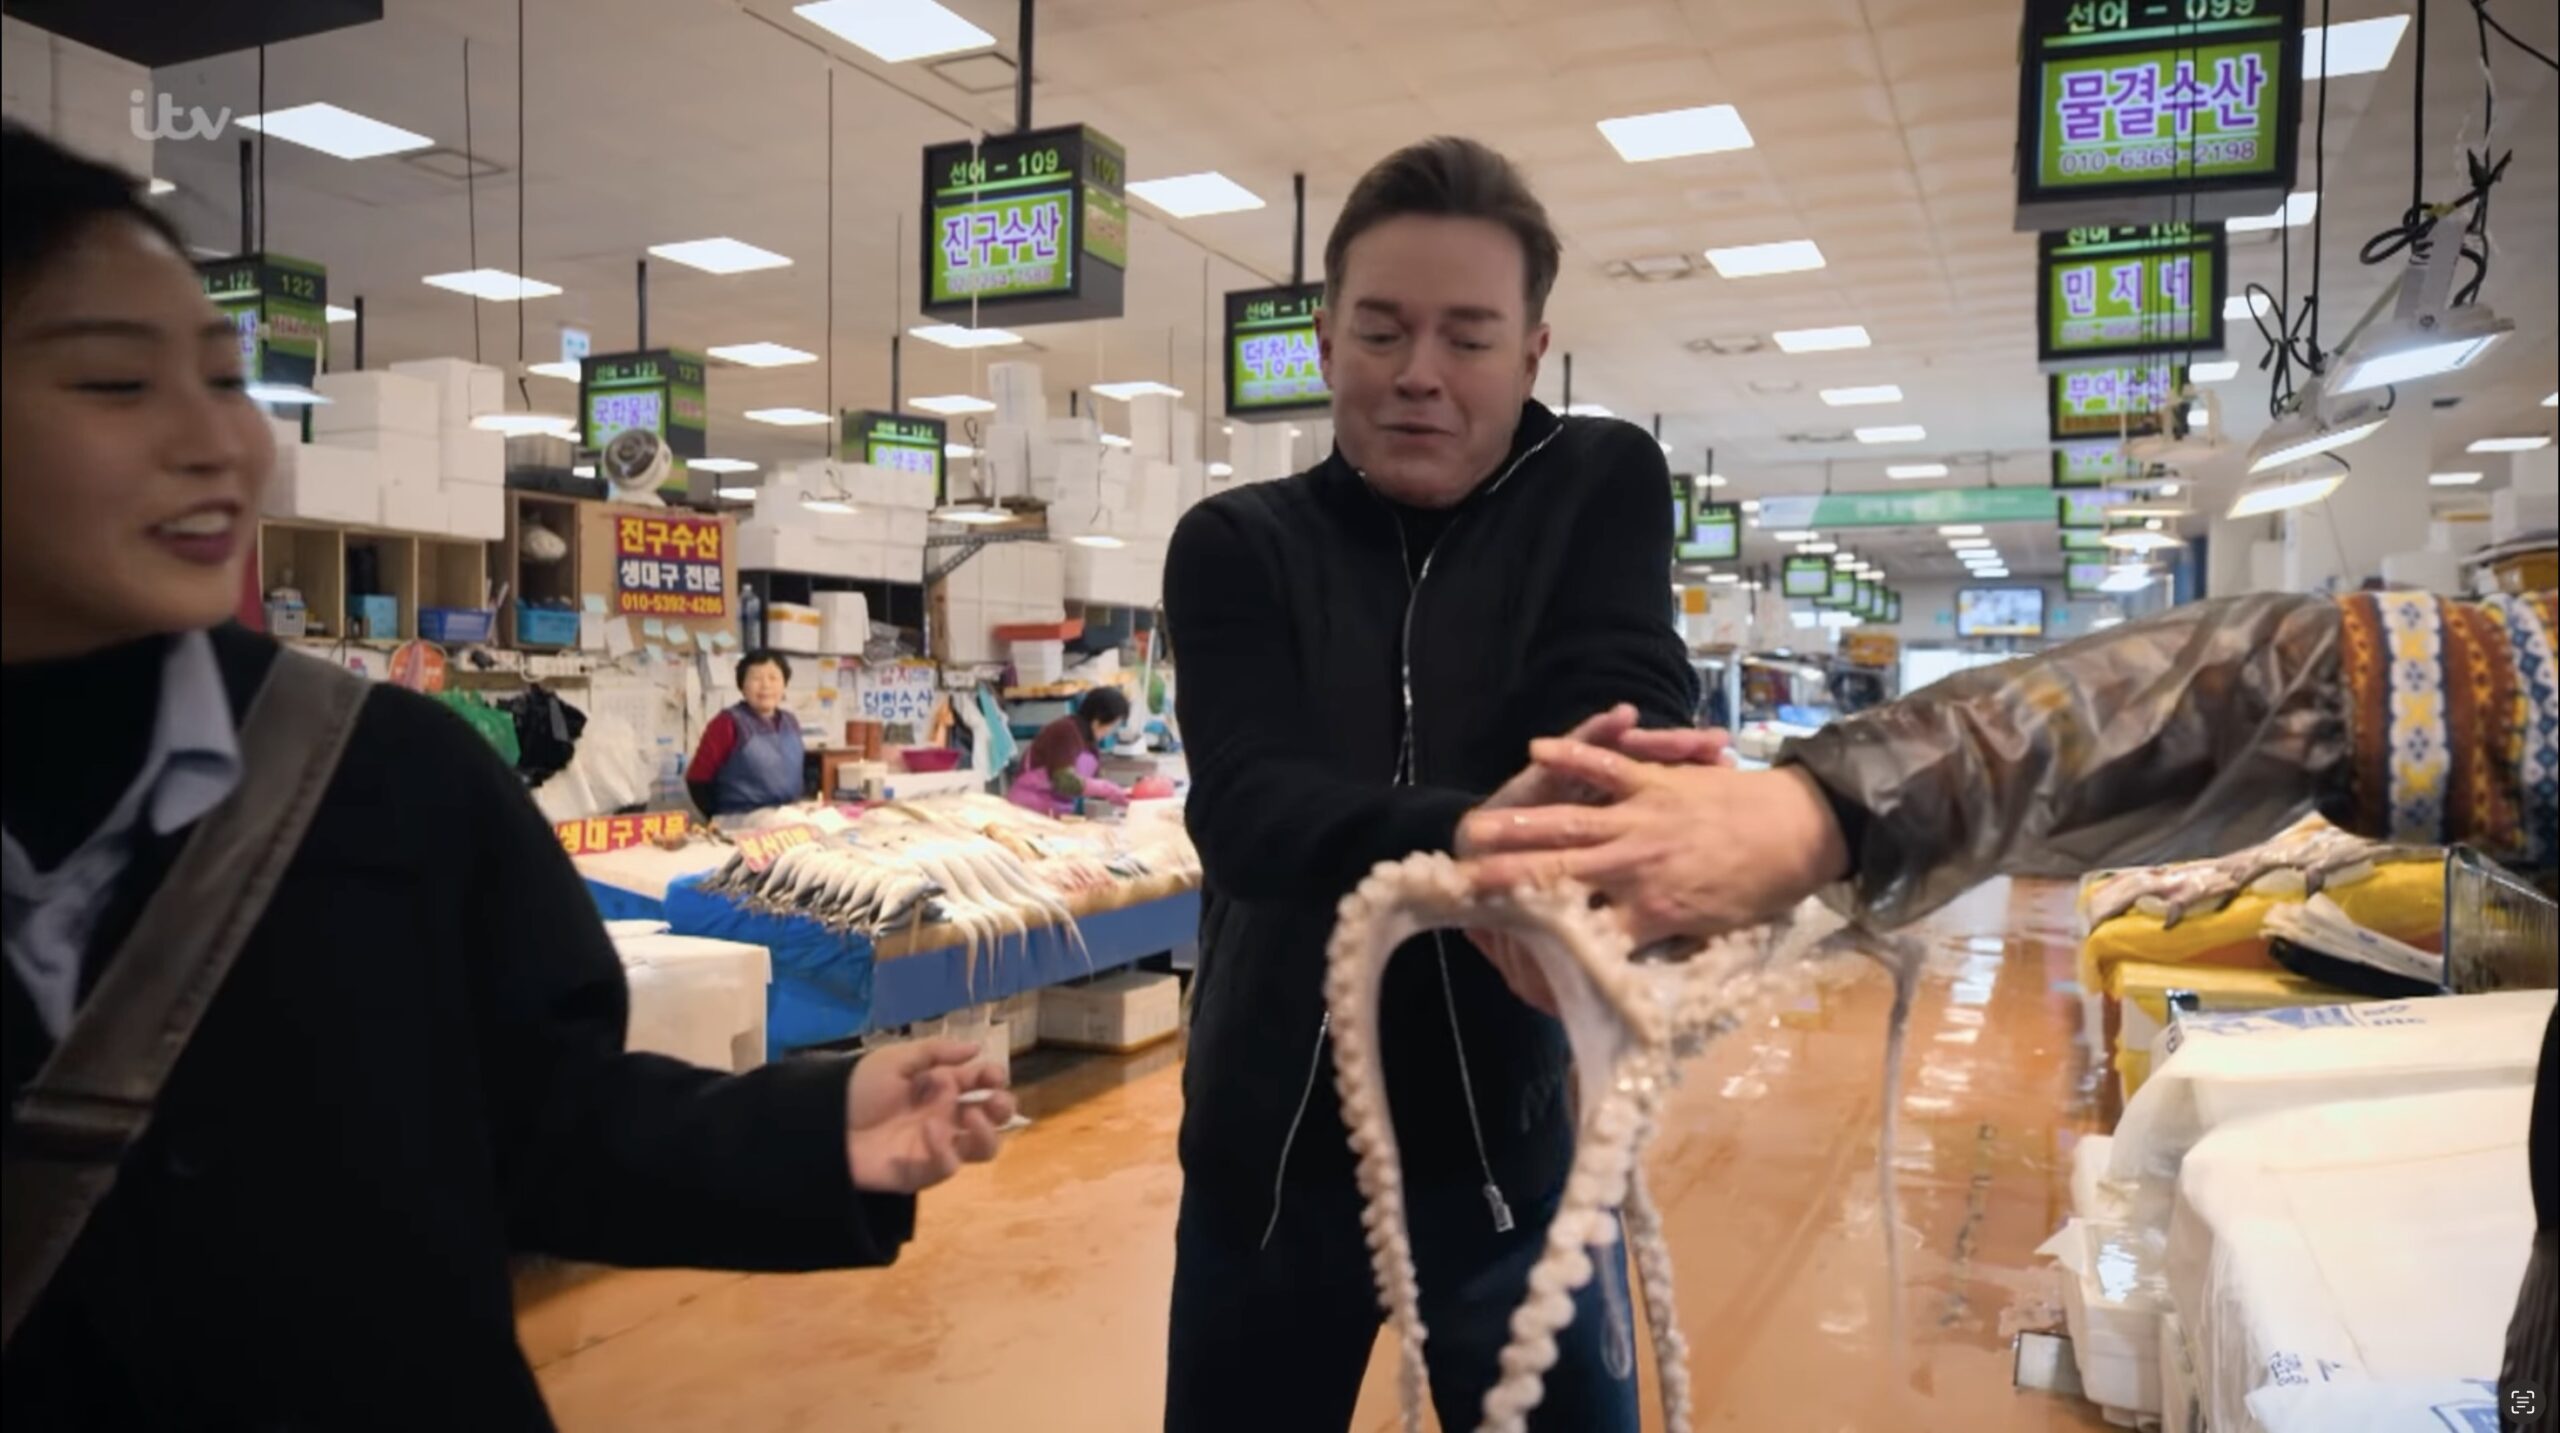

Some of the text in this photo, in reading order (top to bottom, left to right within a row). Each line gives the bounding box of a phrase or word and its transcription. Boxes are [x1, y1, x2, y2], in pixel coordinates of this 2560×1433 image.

[2067, 0, 2128, 33] 선어
[2060, 56, 2266, 141] 물결수산
[951, 159, 986, 185] 선어
[1018, 150, 1058, 175] 109
[2060, 140, 2256, 176] 010-6369-2198
[944, 203, 1060, 267] 진구수산
[282, 274, 315, 300] 122
[1244, 336, 1320, 377] 덕청수
[621, 519, 719, 559] 진구수산
[622, 560, 722, 592] 생대구 전문
[559, 819, 634, 854] 생대구
